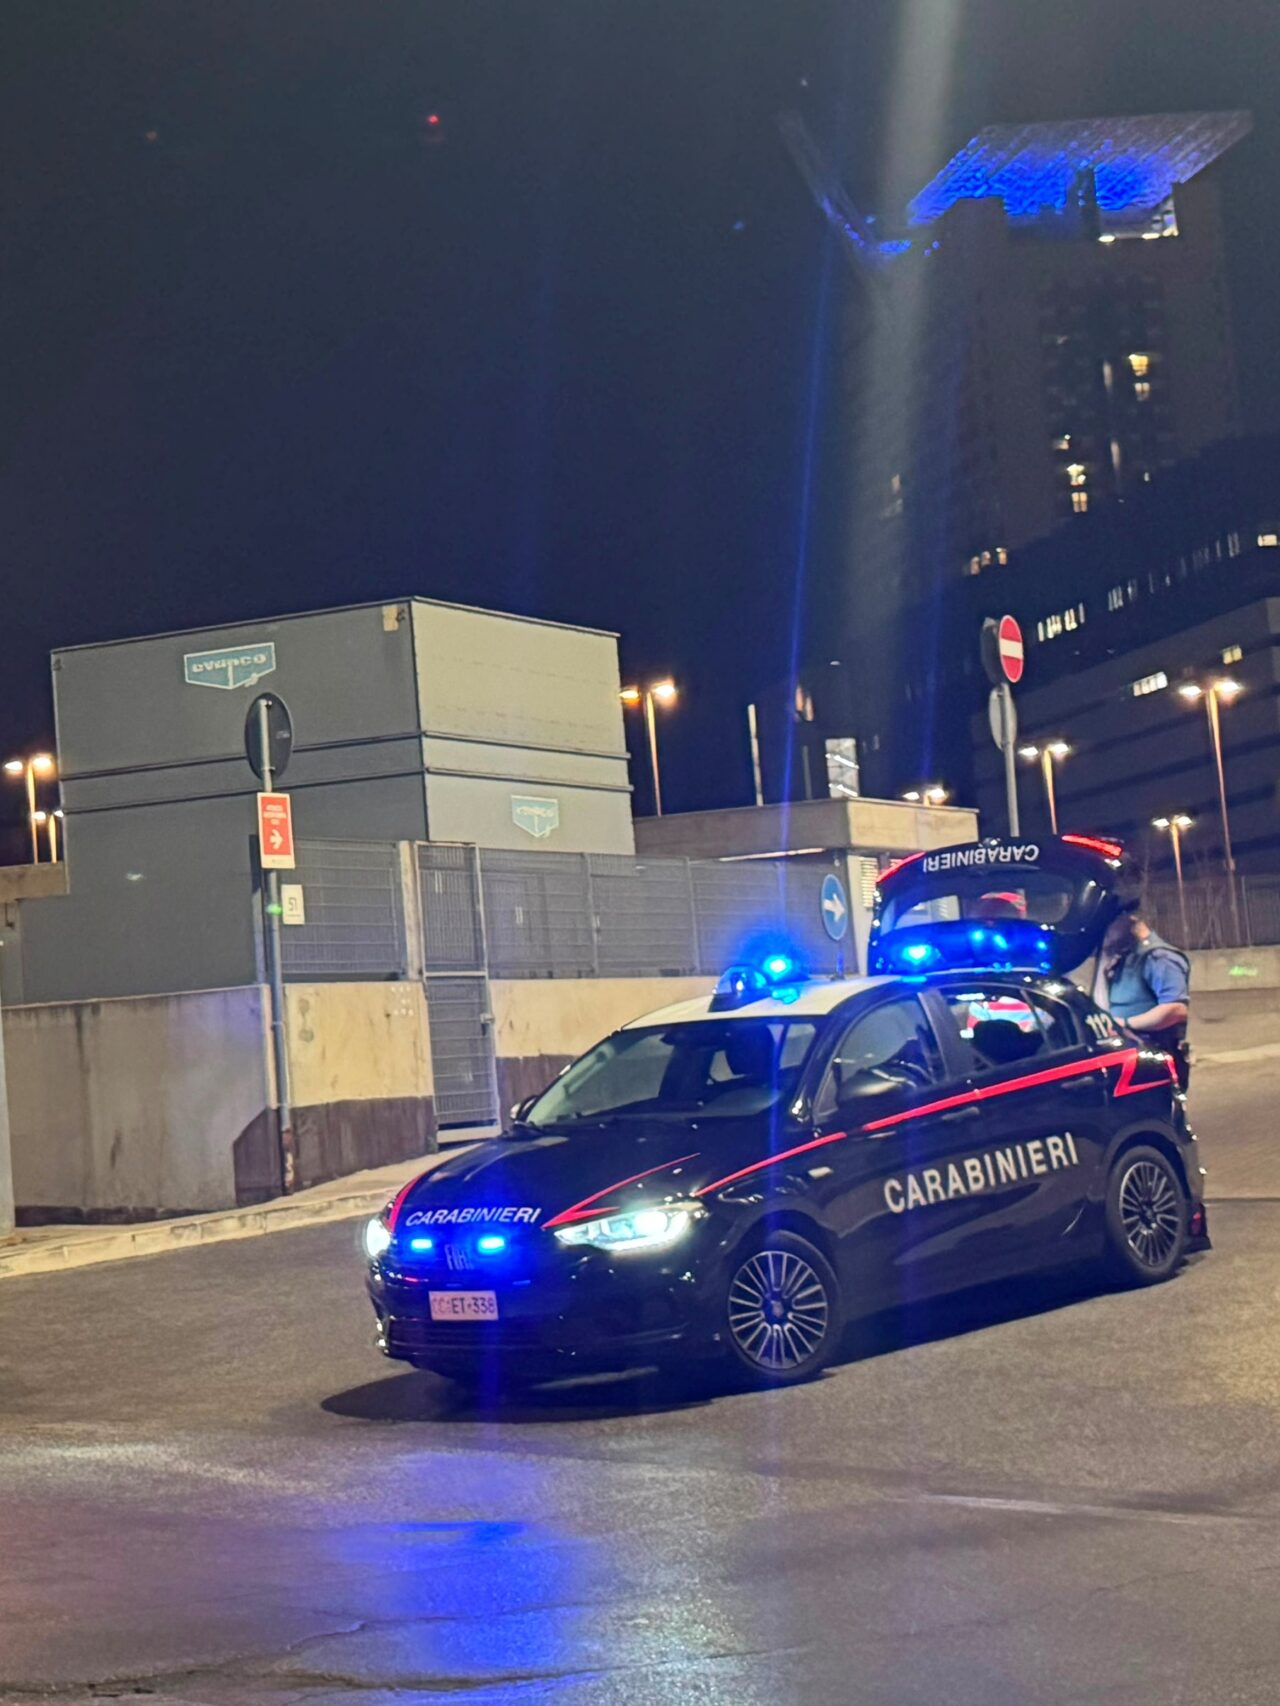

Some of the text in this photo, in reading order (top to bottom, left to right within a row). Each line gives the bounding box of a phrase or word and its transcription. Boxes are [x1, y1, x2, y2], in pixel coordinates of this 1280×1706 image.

[922, 844, 1040, 873] CARABINIERI
[1085, 1013, 1118, 1039] 112
[884, 1131, 1080, 1214] CARABINIERI
[405, 1207, 542, 1226] CARABINIERI
